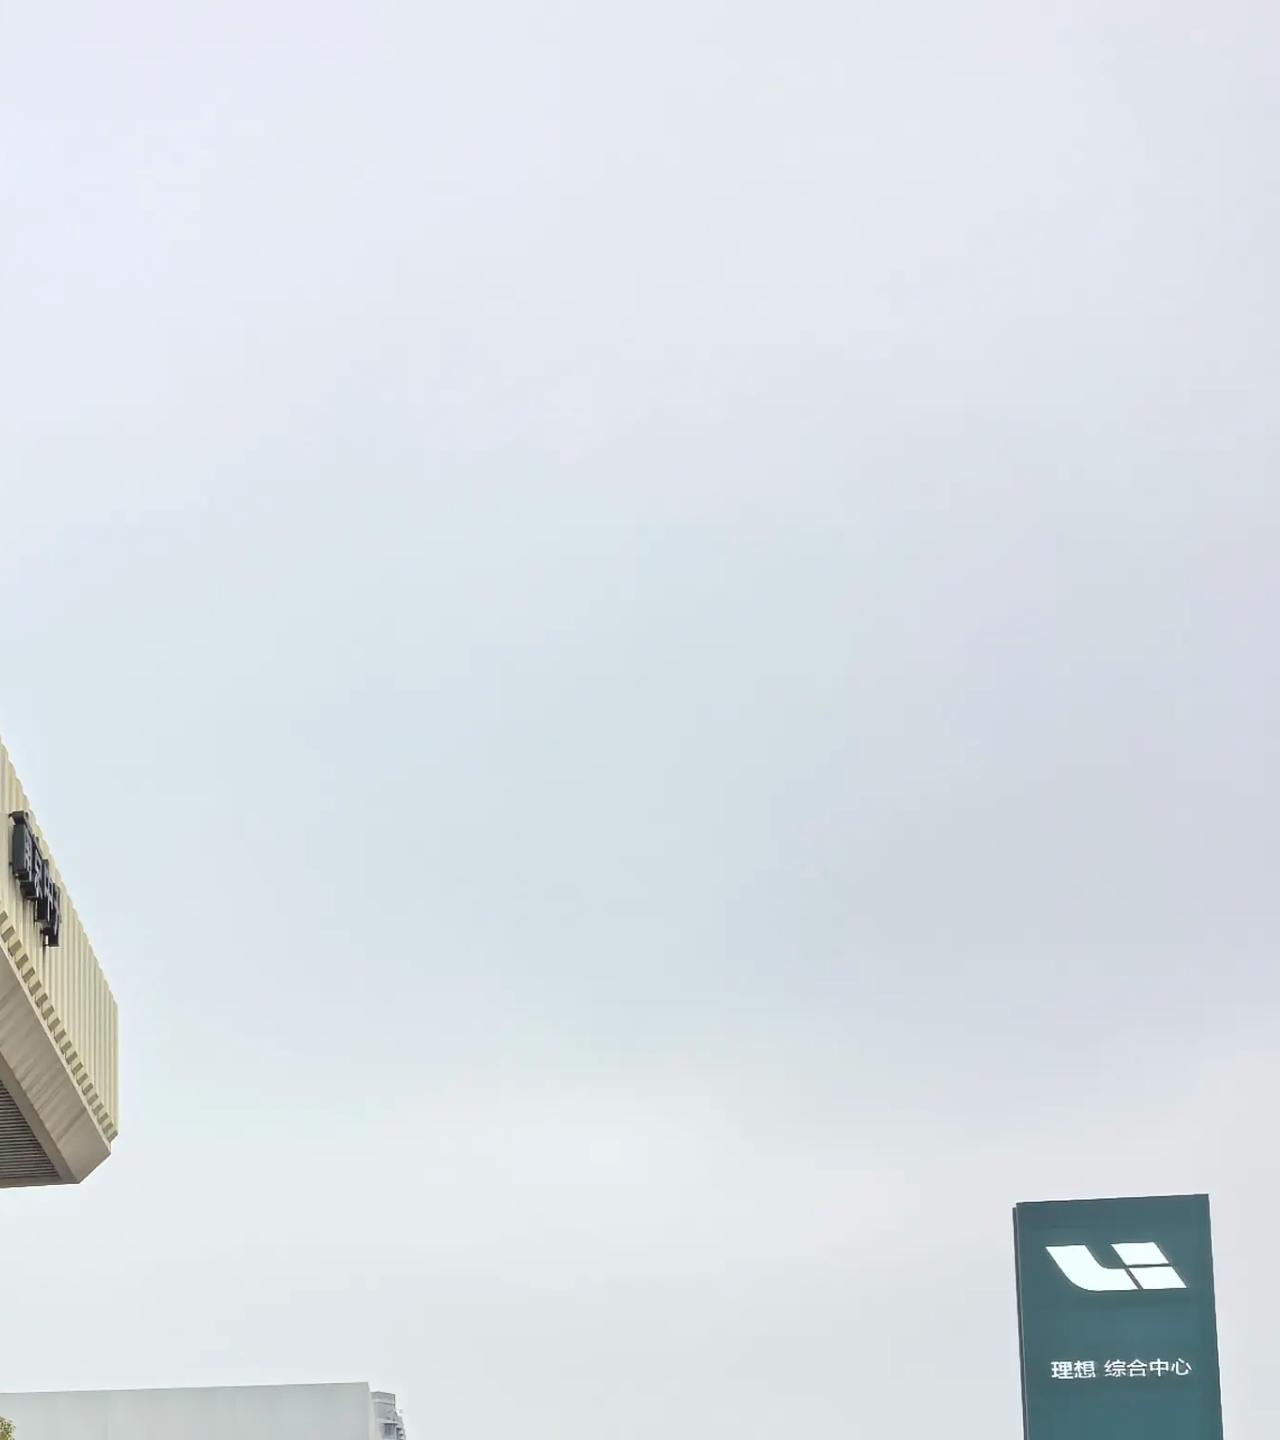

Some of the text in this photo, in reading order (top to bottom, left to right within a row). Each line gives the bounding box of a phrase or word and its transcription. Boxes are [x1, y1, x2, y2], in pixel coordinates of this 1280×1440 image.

[1050, 1358, 1192, 1379] 理想 综合中心
